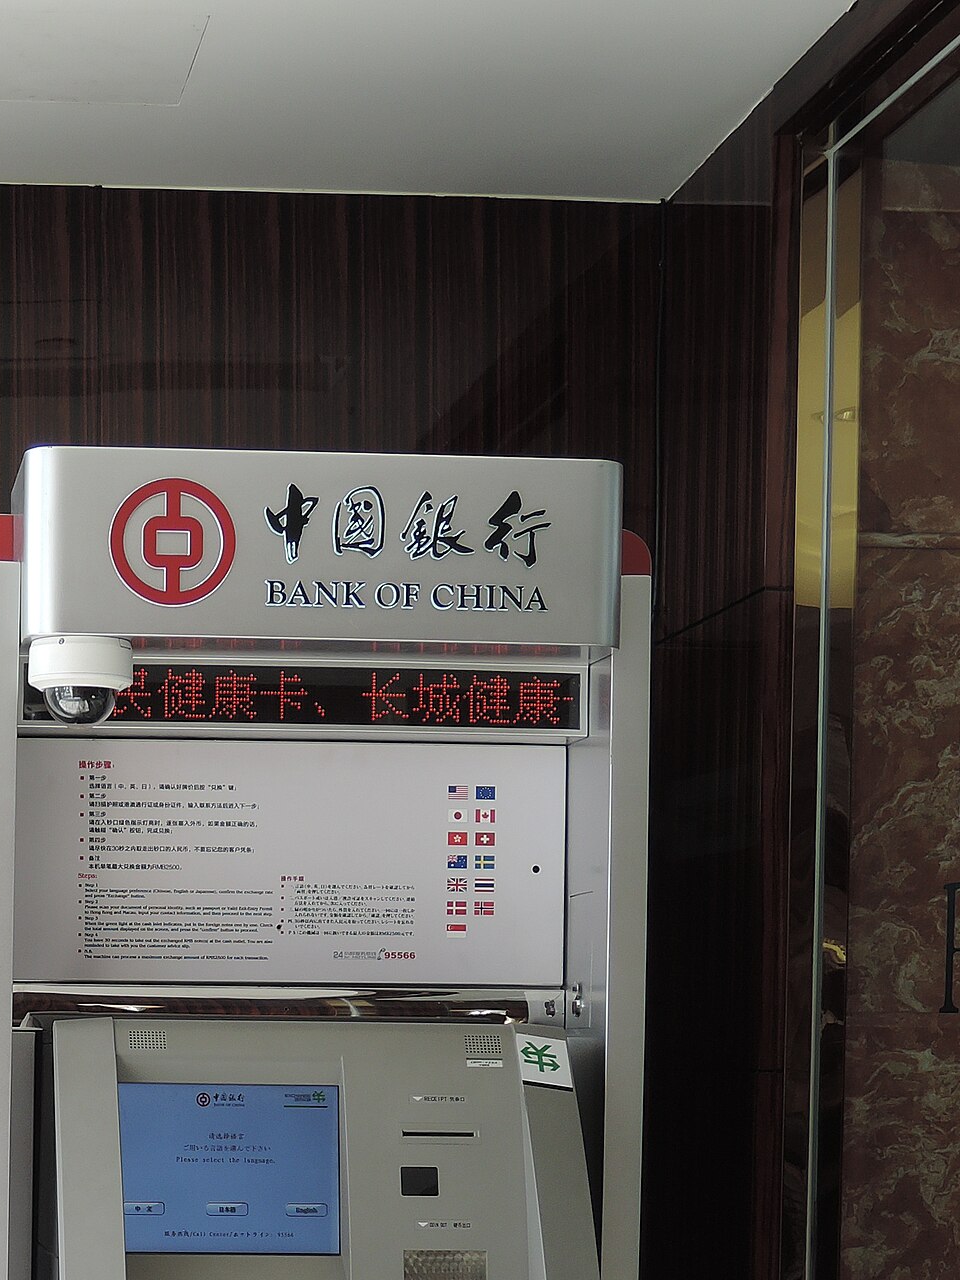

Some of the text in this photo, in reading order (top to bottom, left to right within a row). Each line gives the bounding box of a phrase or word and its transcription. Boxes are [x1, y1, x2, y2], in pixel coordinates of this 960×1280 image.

[264, 579, 548, 612] BANK OF CHINA
